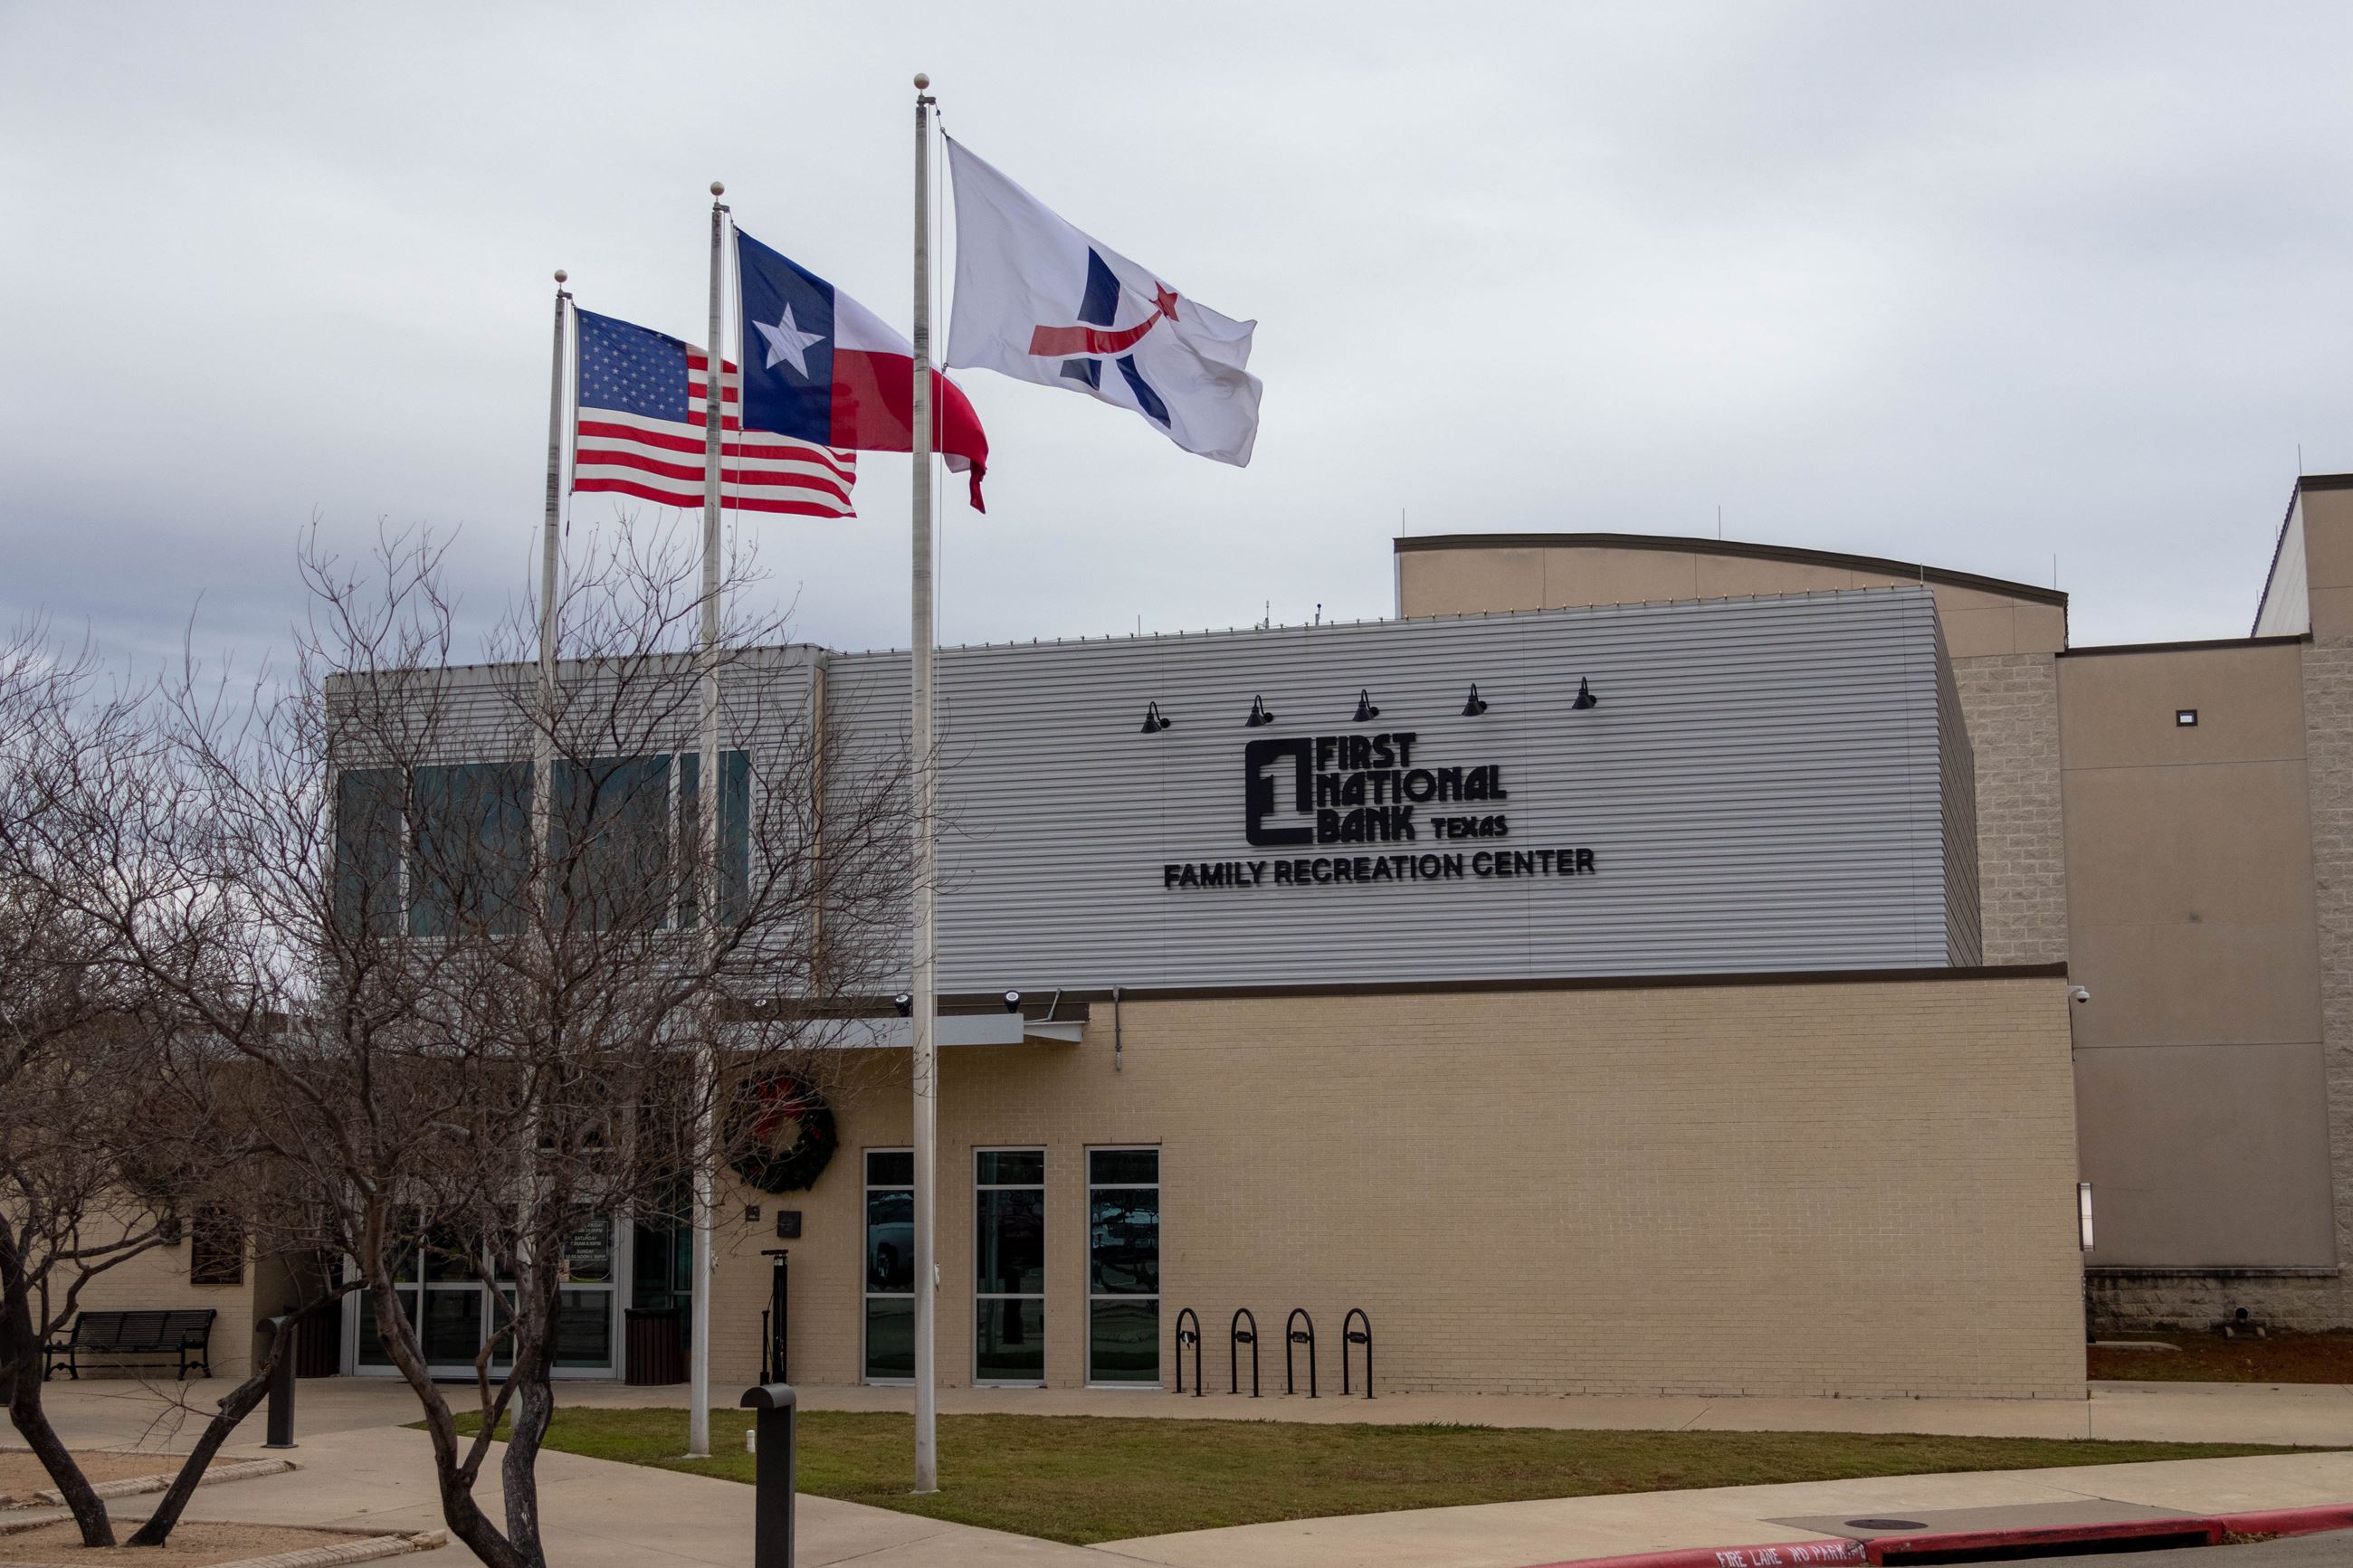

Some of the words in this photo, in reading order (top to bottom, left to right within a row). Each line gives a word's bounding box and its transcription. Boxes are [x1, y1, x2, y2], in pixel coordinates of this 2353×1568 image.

[1316, 733, 1416, 771] FIRST
[1317, 765, 1507, 807] NATIONAL
[1317, 805, 1415, 843] BANK
[1431, 815, 1509, 839] TEXAS
[1164, 860, 1267, 889] FAMILY
[1274, 853, 1464, 886] RECREATION
[1472, 848, 1596, 878] CENTER
[1715, 1549, 1747, 1568] FIRE
[1748, 1548, 1782, 1565] LANE
[1787, 1546, 1810, 1563] NO
